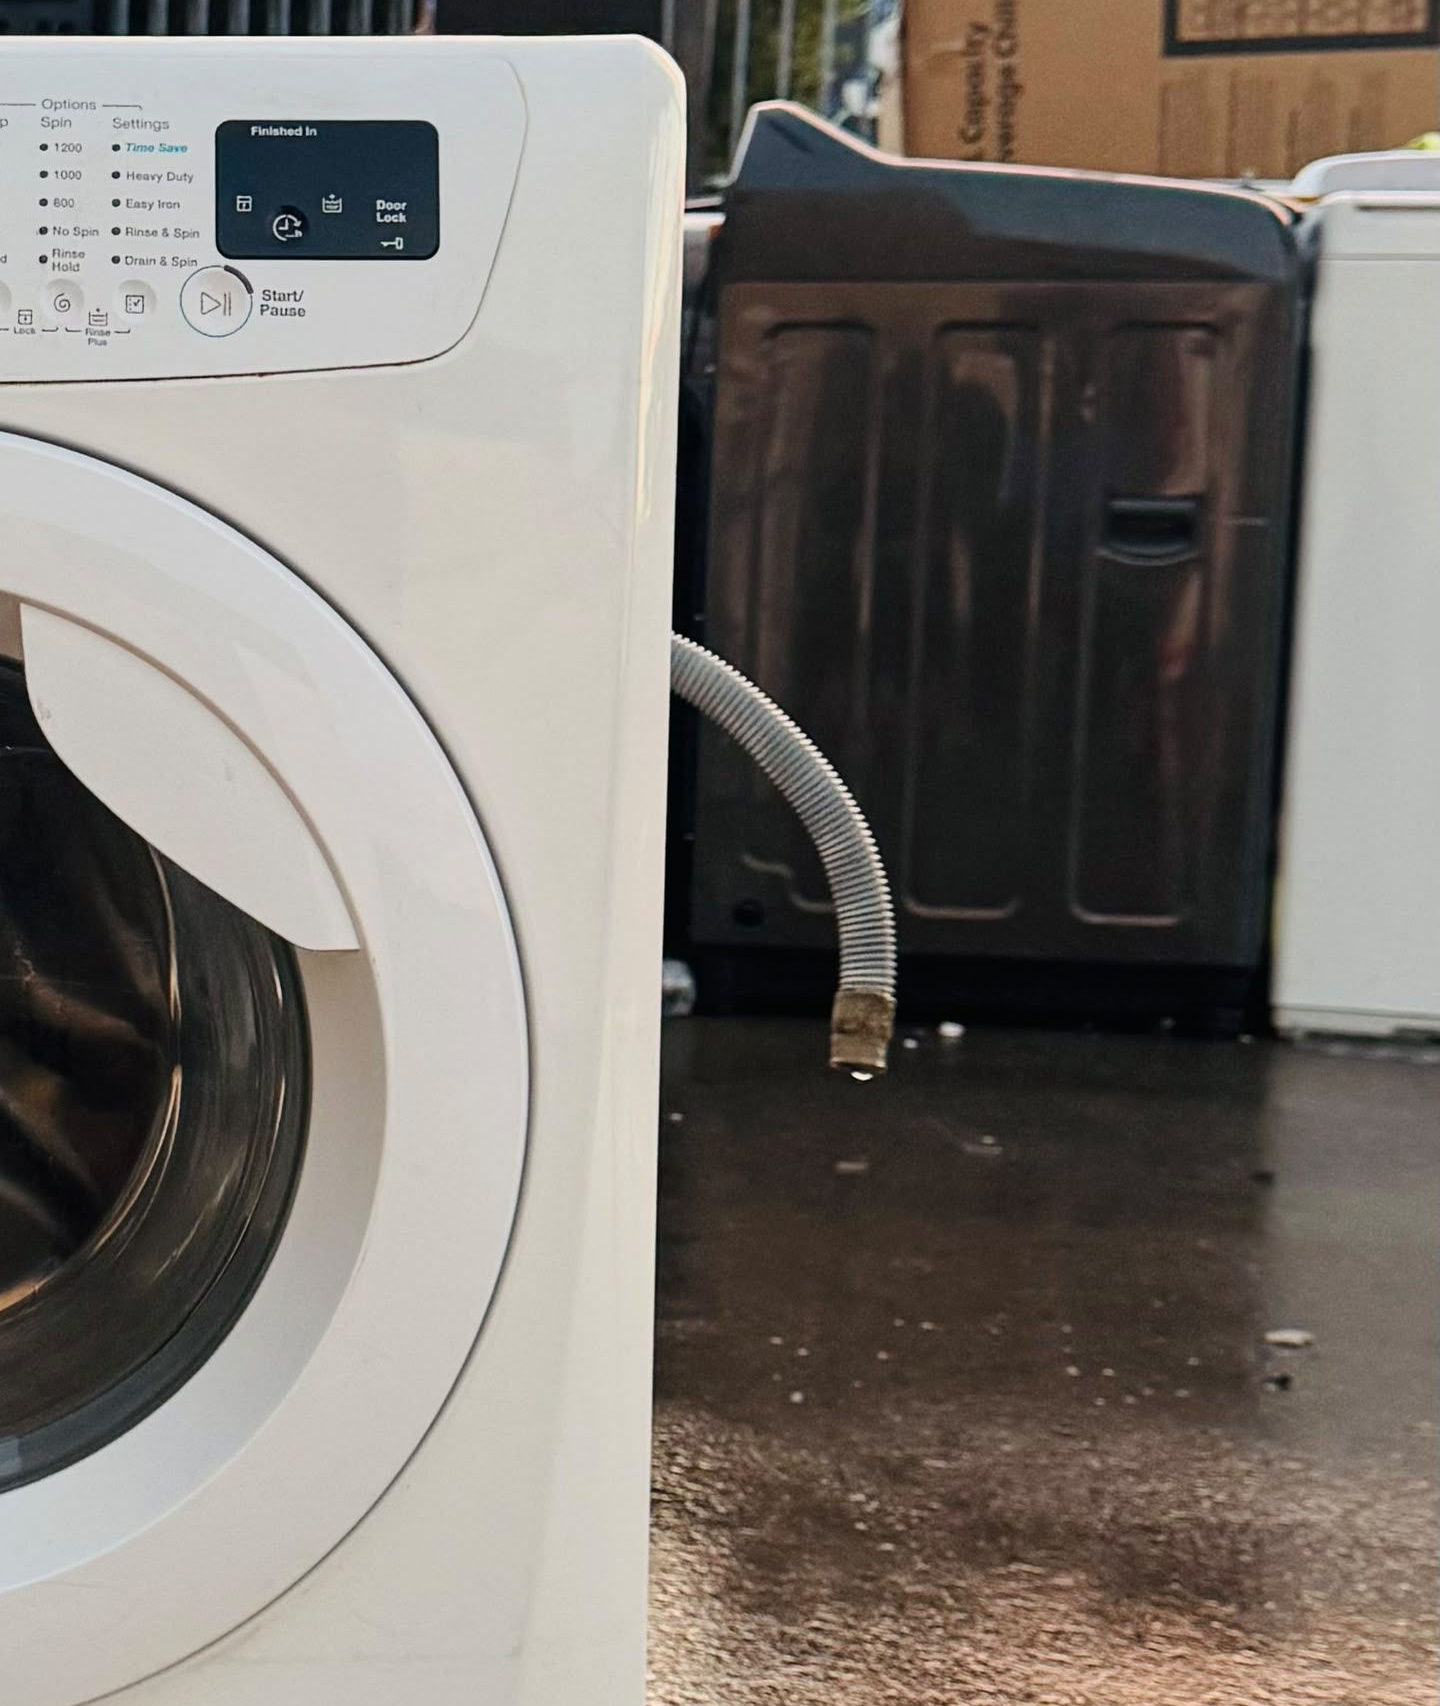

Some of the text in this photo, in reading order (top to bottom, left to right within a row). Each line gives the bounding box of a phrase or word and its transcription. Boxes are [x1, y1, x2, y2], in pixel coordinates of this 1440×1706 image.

[41, 98, 97, 112] Options
[40, 116, 72, 130] Spin
[112, 117, 170, 132] Settings
[251, 126, 302, 137] Finished
[54, 143, 82, 153] 1200
[126, 143, 188, 153] Time Save
[54, 170, 82, 180] 1000
[126, 171, 194, 184] Heavy Duty
[125, 198, 181, 211] Easy Iron
[376, 199, 407, 211] Door
[376, 212, 407, 223] Lock
[52, 226, 100, 238] No Spin
[125, 226, 200, 240] Rinse & Spin
[51, 248, 86, 259] Rinse
[51, 262, 81, 272] Hold
[124, 255, 198, 269] Drain & Spin
[262, 289, 304, 302] Start/
[260, 304, 306, 317] Pause
[13, 326, 36, 335] Lock
[85, 328, 111, 337] Rinse
[87, 338, 108, 346] Plus
